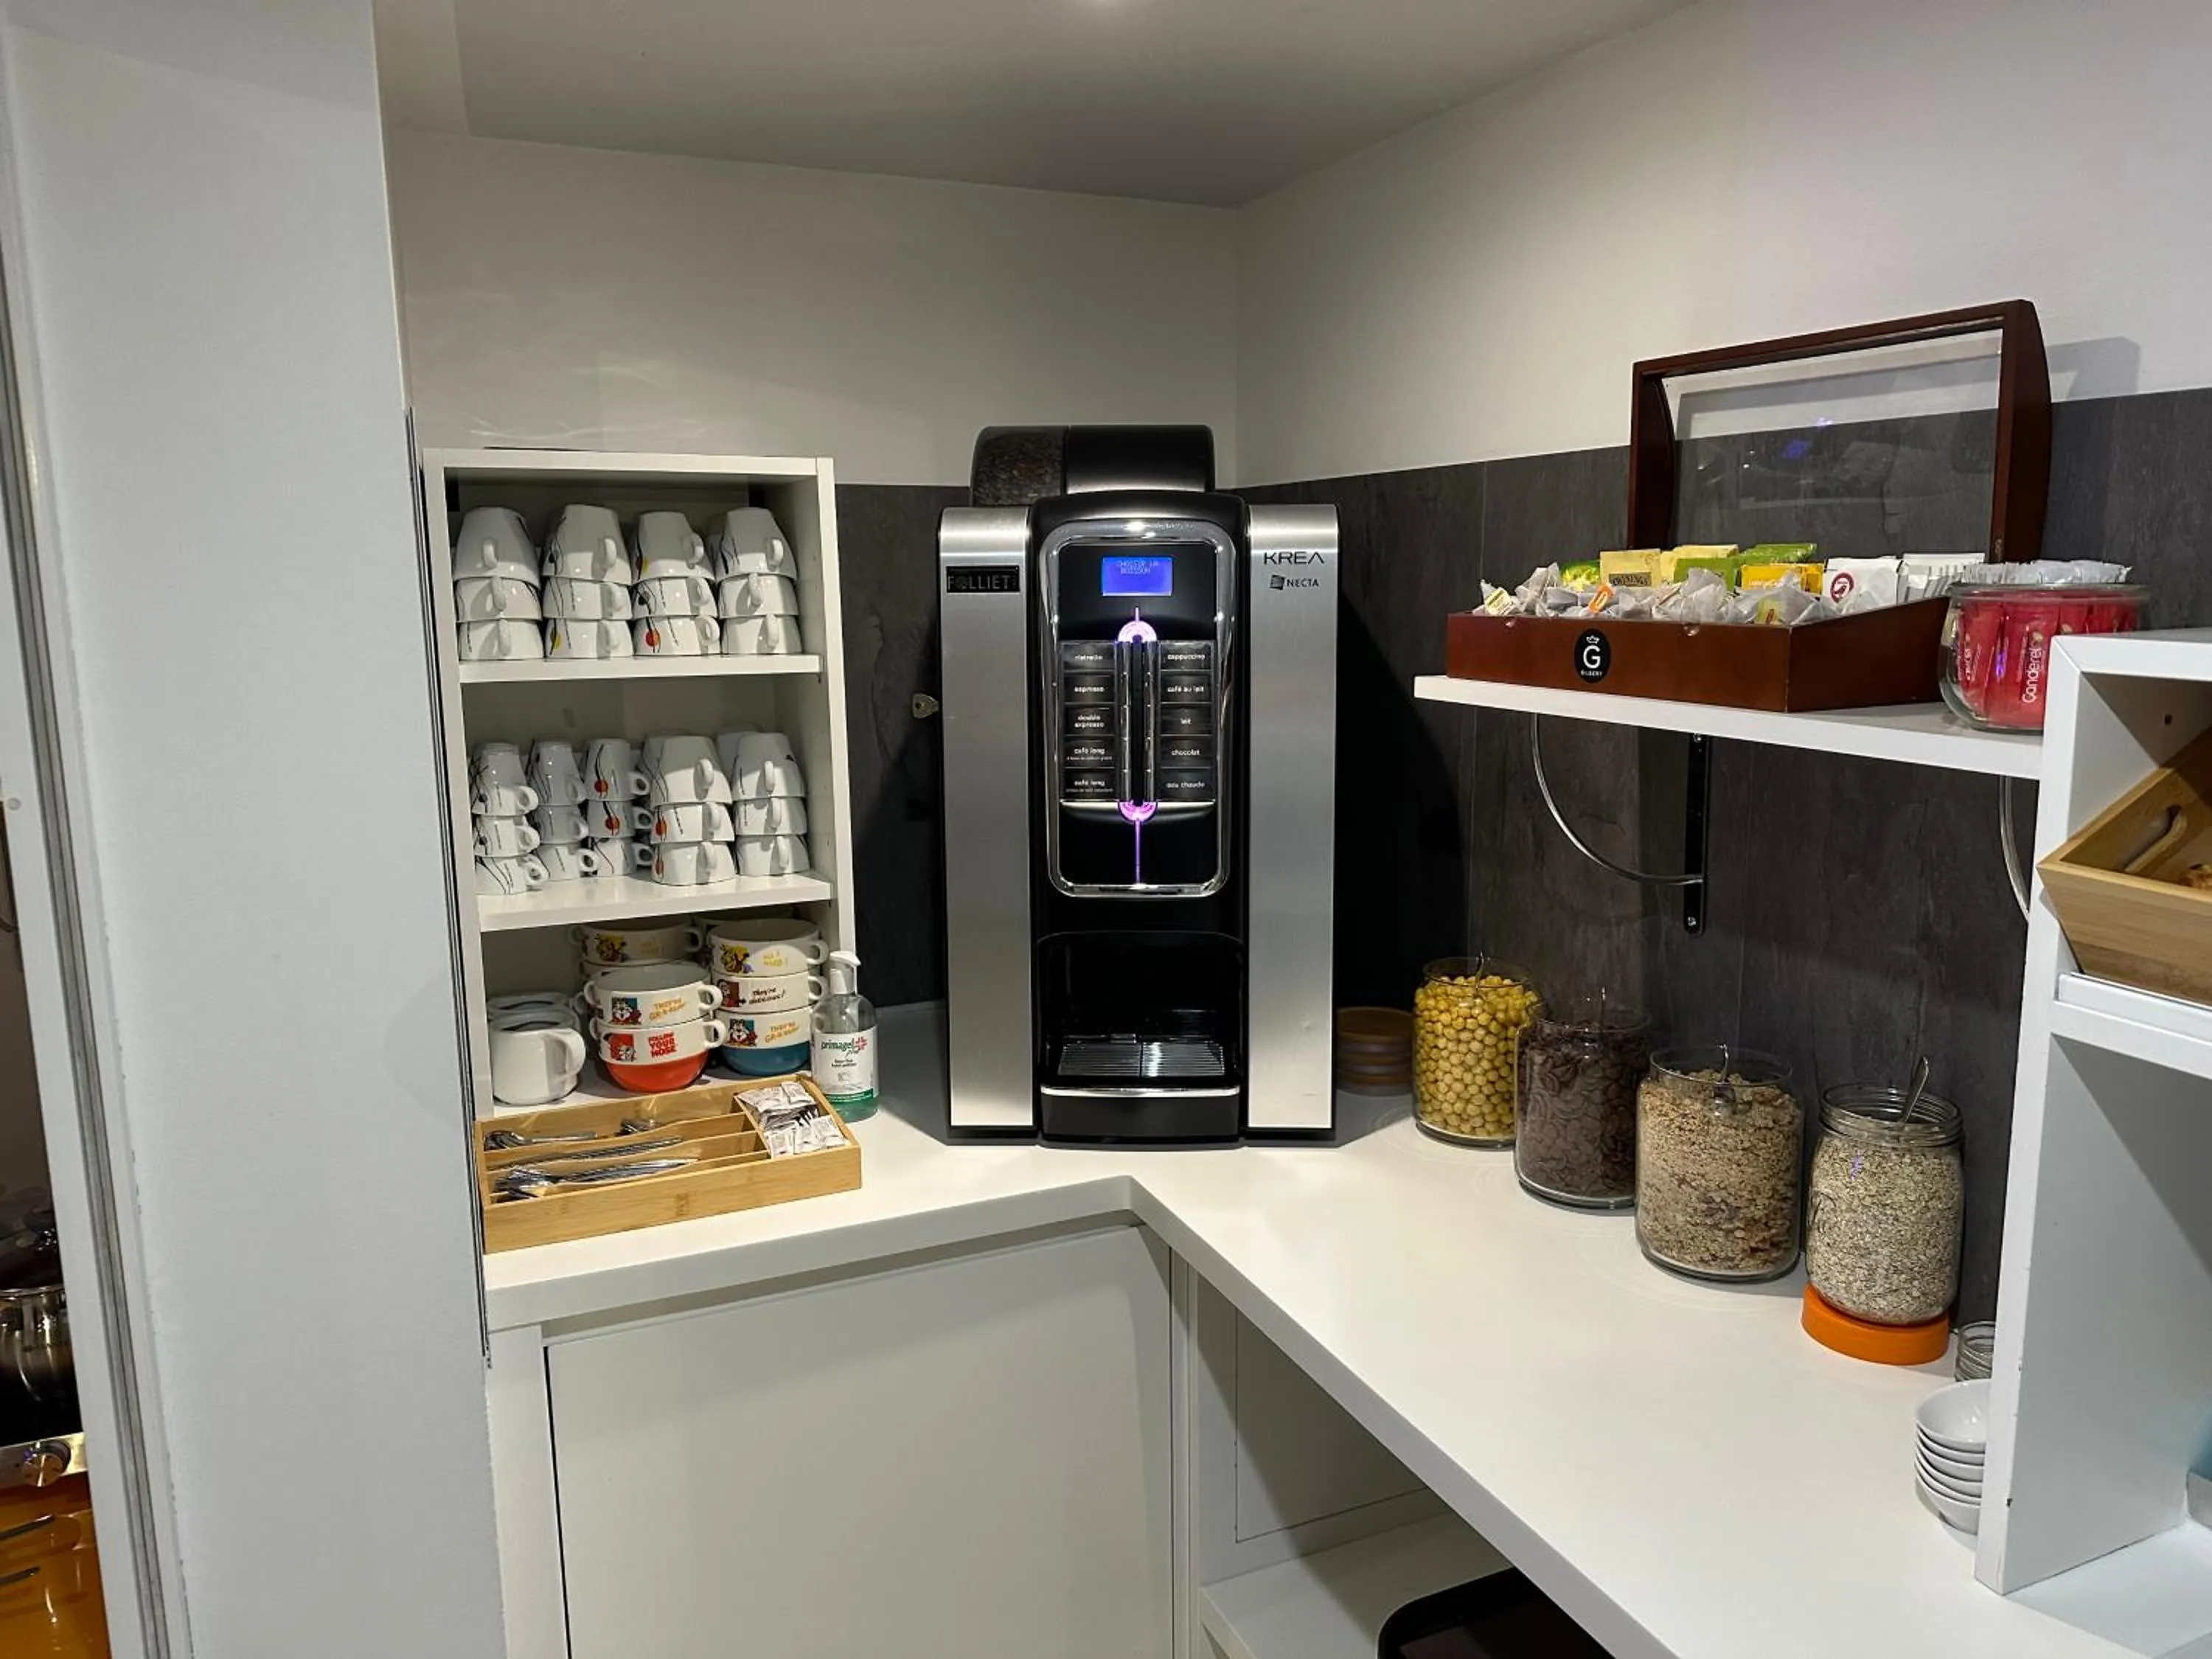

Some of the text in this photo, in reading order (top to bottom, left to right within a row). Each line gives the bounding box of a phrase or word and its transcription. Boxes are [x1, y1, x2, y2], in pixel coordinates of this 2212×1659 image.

[1264, 552, 1324, 565] KREA
[1287, 579, 1319, 588] NECTA
[1583, 644, 1601, 669] G
[2022, 647, 2042, 703] Canderel
